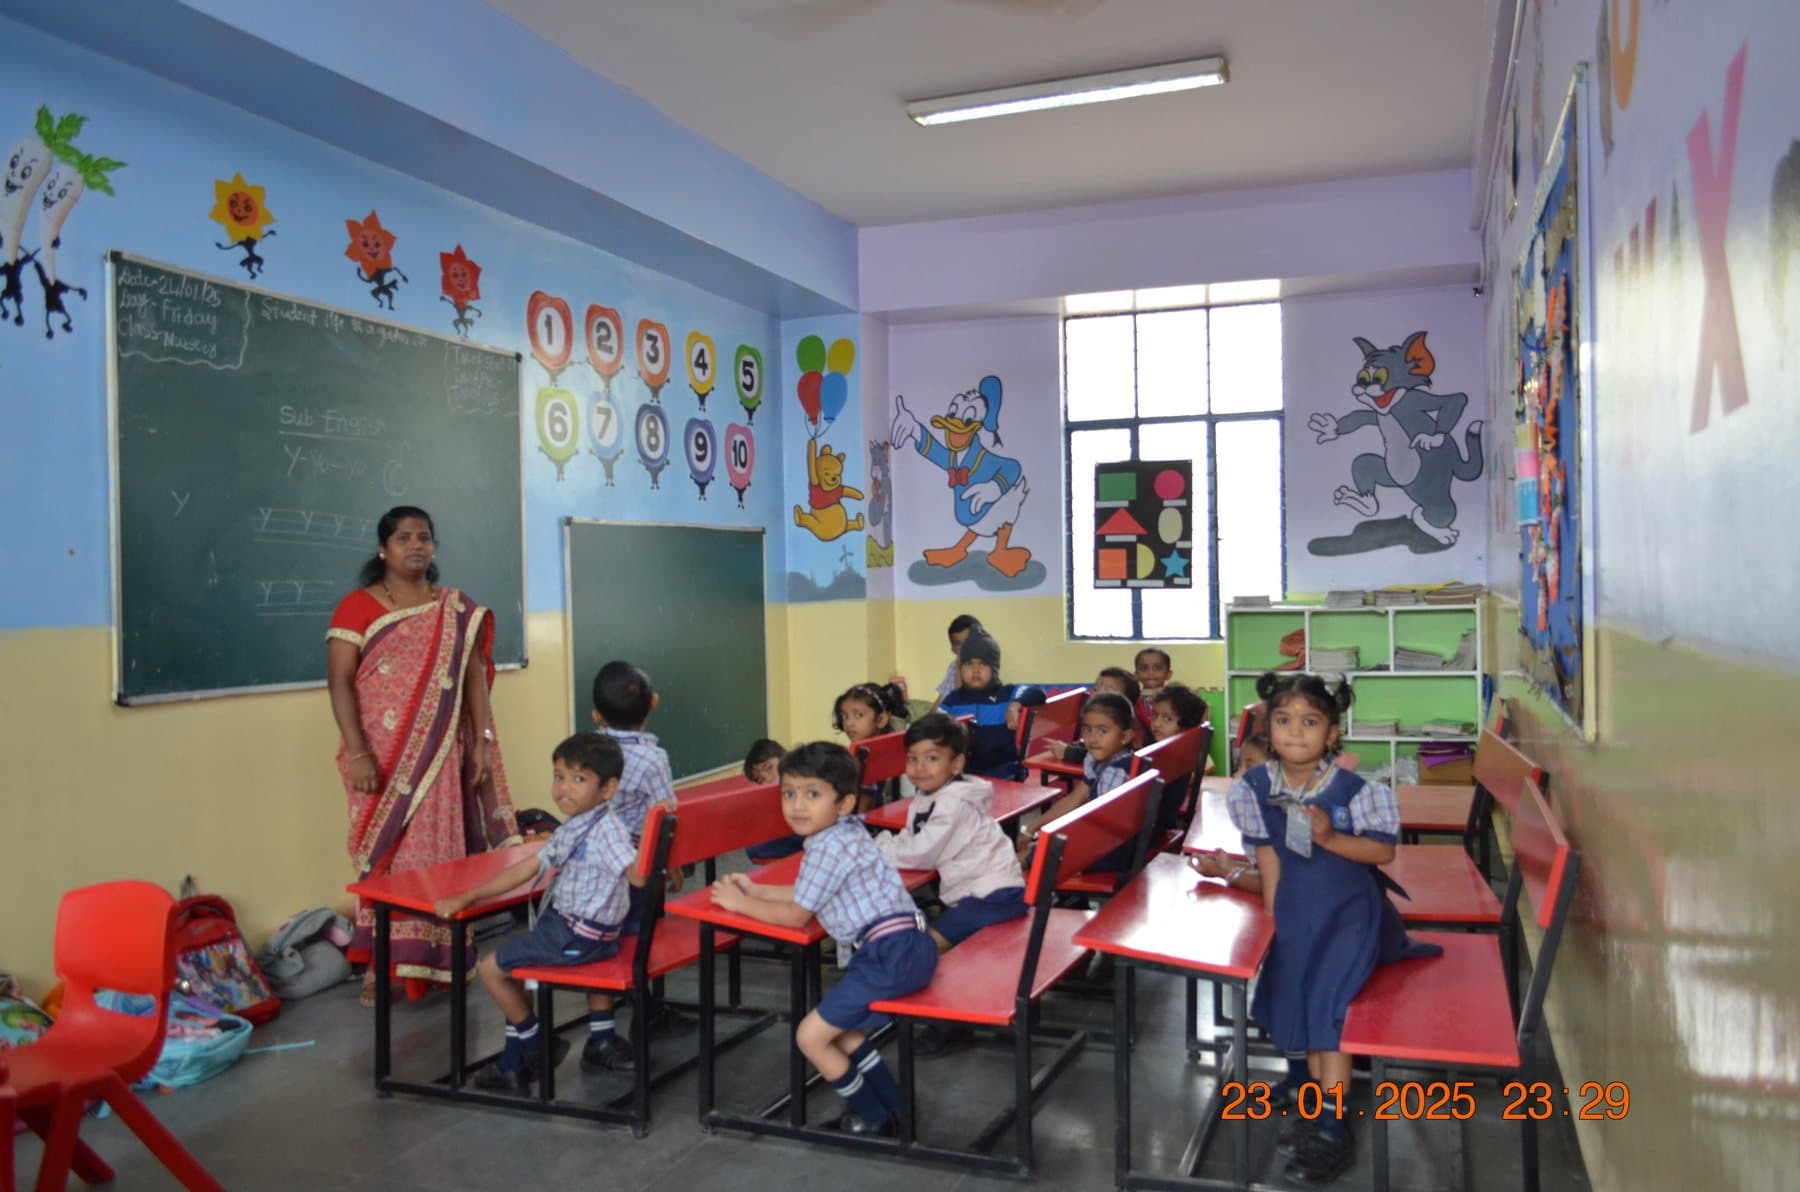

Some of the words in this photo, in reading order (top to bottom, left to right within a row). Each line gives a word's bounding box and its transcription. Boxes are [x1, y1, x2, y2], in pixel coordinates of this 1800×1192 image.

[163, 298, 218, 336] Friday
[261, 297, 318, 327] Student
[544, 313, 554, 346] 1
[595, 320, 614, 355] 2
[645, 333, 660, 365] 3
[694, 347, 709, 376] 4
[741, 360, 755, 393] 5
[279, 404, 314, 427] Sub
[548, 402, 569, 442] 6
[596, 406, 613, 440] 7
[645, 415, 661, 453] 8
[694, 431, 709, 463] 9
[732, 439, 749, 470] 10
